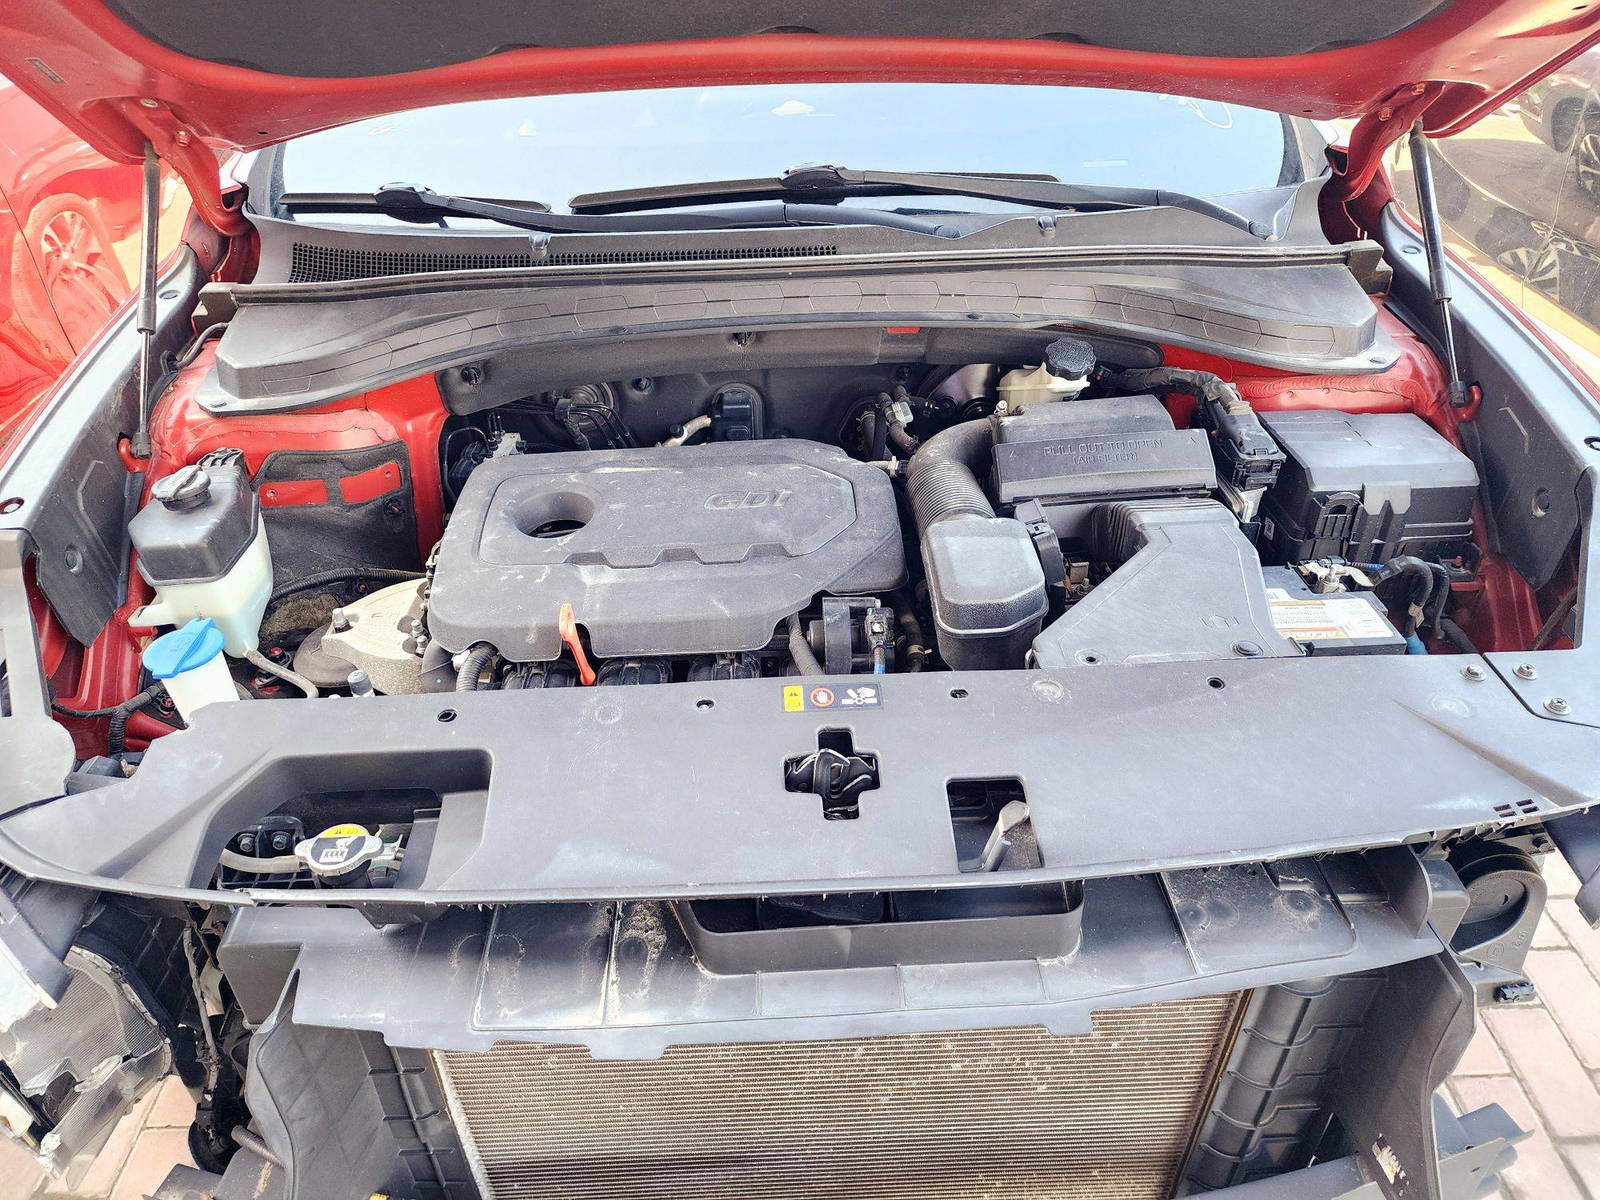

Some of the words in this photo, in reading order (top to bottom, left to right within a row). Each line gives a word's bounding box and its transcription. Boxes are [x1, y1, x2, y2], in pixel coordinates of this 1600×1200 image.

[1043, 444, 1076, 456] PULL
[1079, 441, 1104, 454] OUT
[1106, 440, 1125, 451] TO
[1127, 438, 1163, 449] OPEN
